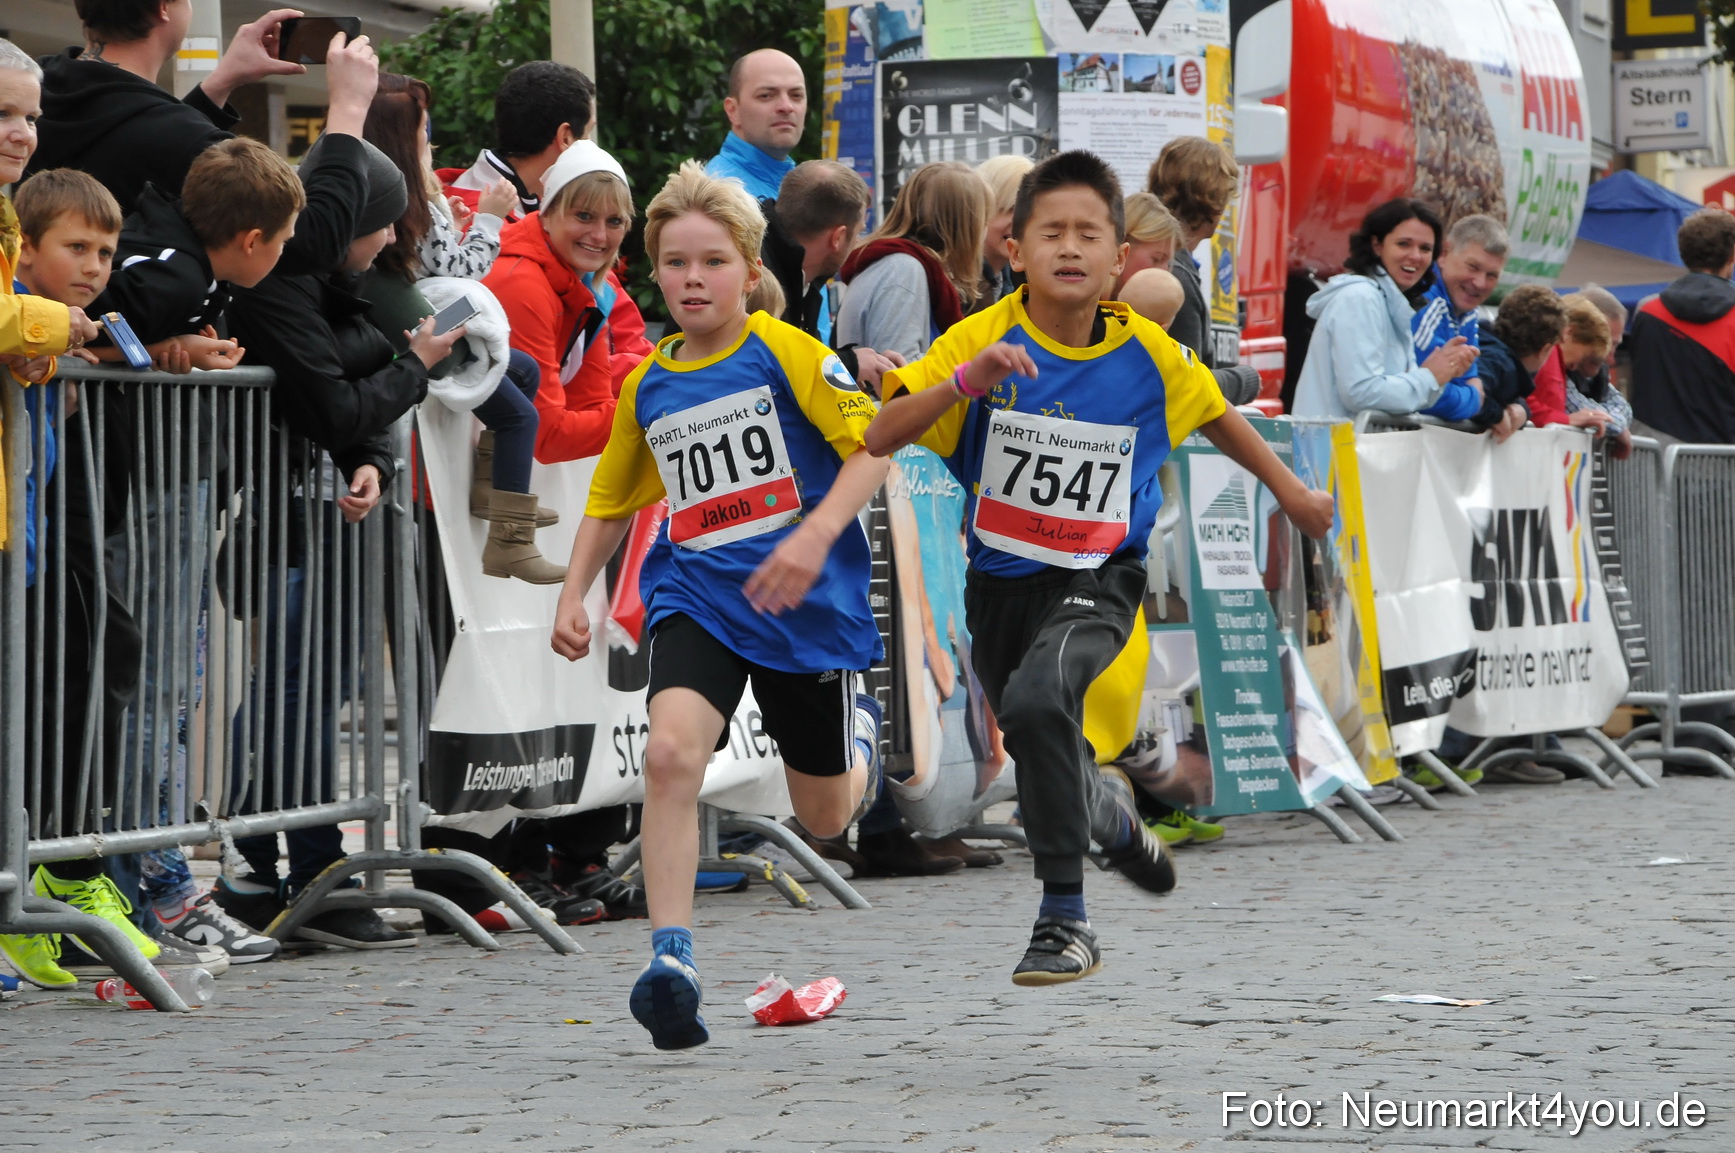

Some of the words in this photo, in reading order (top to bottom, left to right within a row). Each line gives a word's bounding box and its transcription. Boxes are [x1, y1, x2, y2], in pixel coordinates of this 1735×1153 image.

[1630, 87, 1691, 106] Stern
[897, 102, 1037, 137] GLENN
[1149, 106, 1161, 116] für
[898, 135, 1037, 166] MILLER
[1508, 148, 1579, 250] Pellets
[650, 427, 686, 449] PARTL
[688, 407, 750, 436] Neumarkt
[992, 423, 1044, 444] PARTL
[1048, 433, 1115, 453] Neumarkt
[666, 425, 775, 501] 7019
[778, 467, 785, 475] K
[984, 487, 992, 497] 6
[1001, 445, 1121, 513] 7547
[700, 498, 751, 529] Jakob
[1116, 511, 1122, 519] K
[1025, 516, 1087, 542] Julian
[1073, 547, 1110, 560] 2005
[1073, 596, 1095, 608] JAKO
